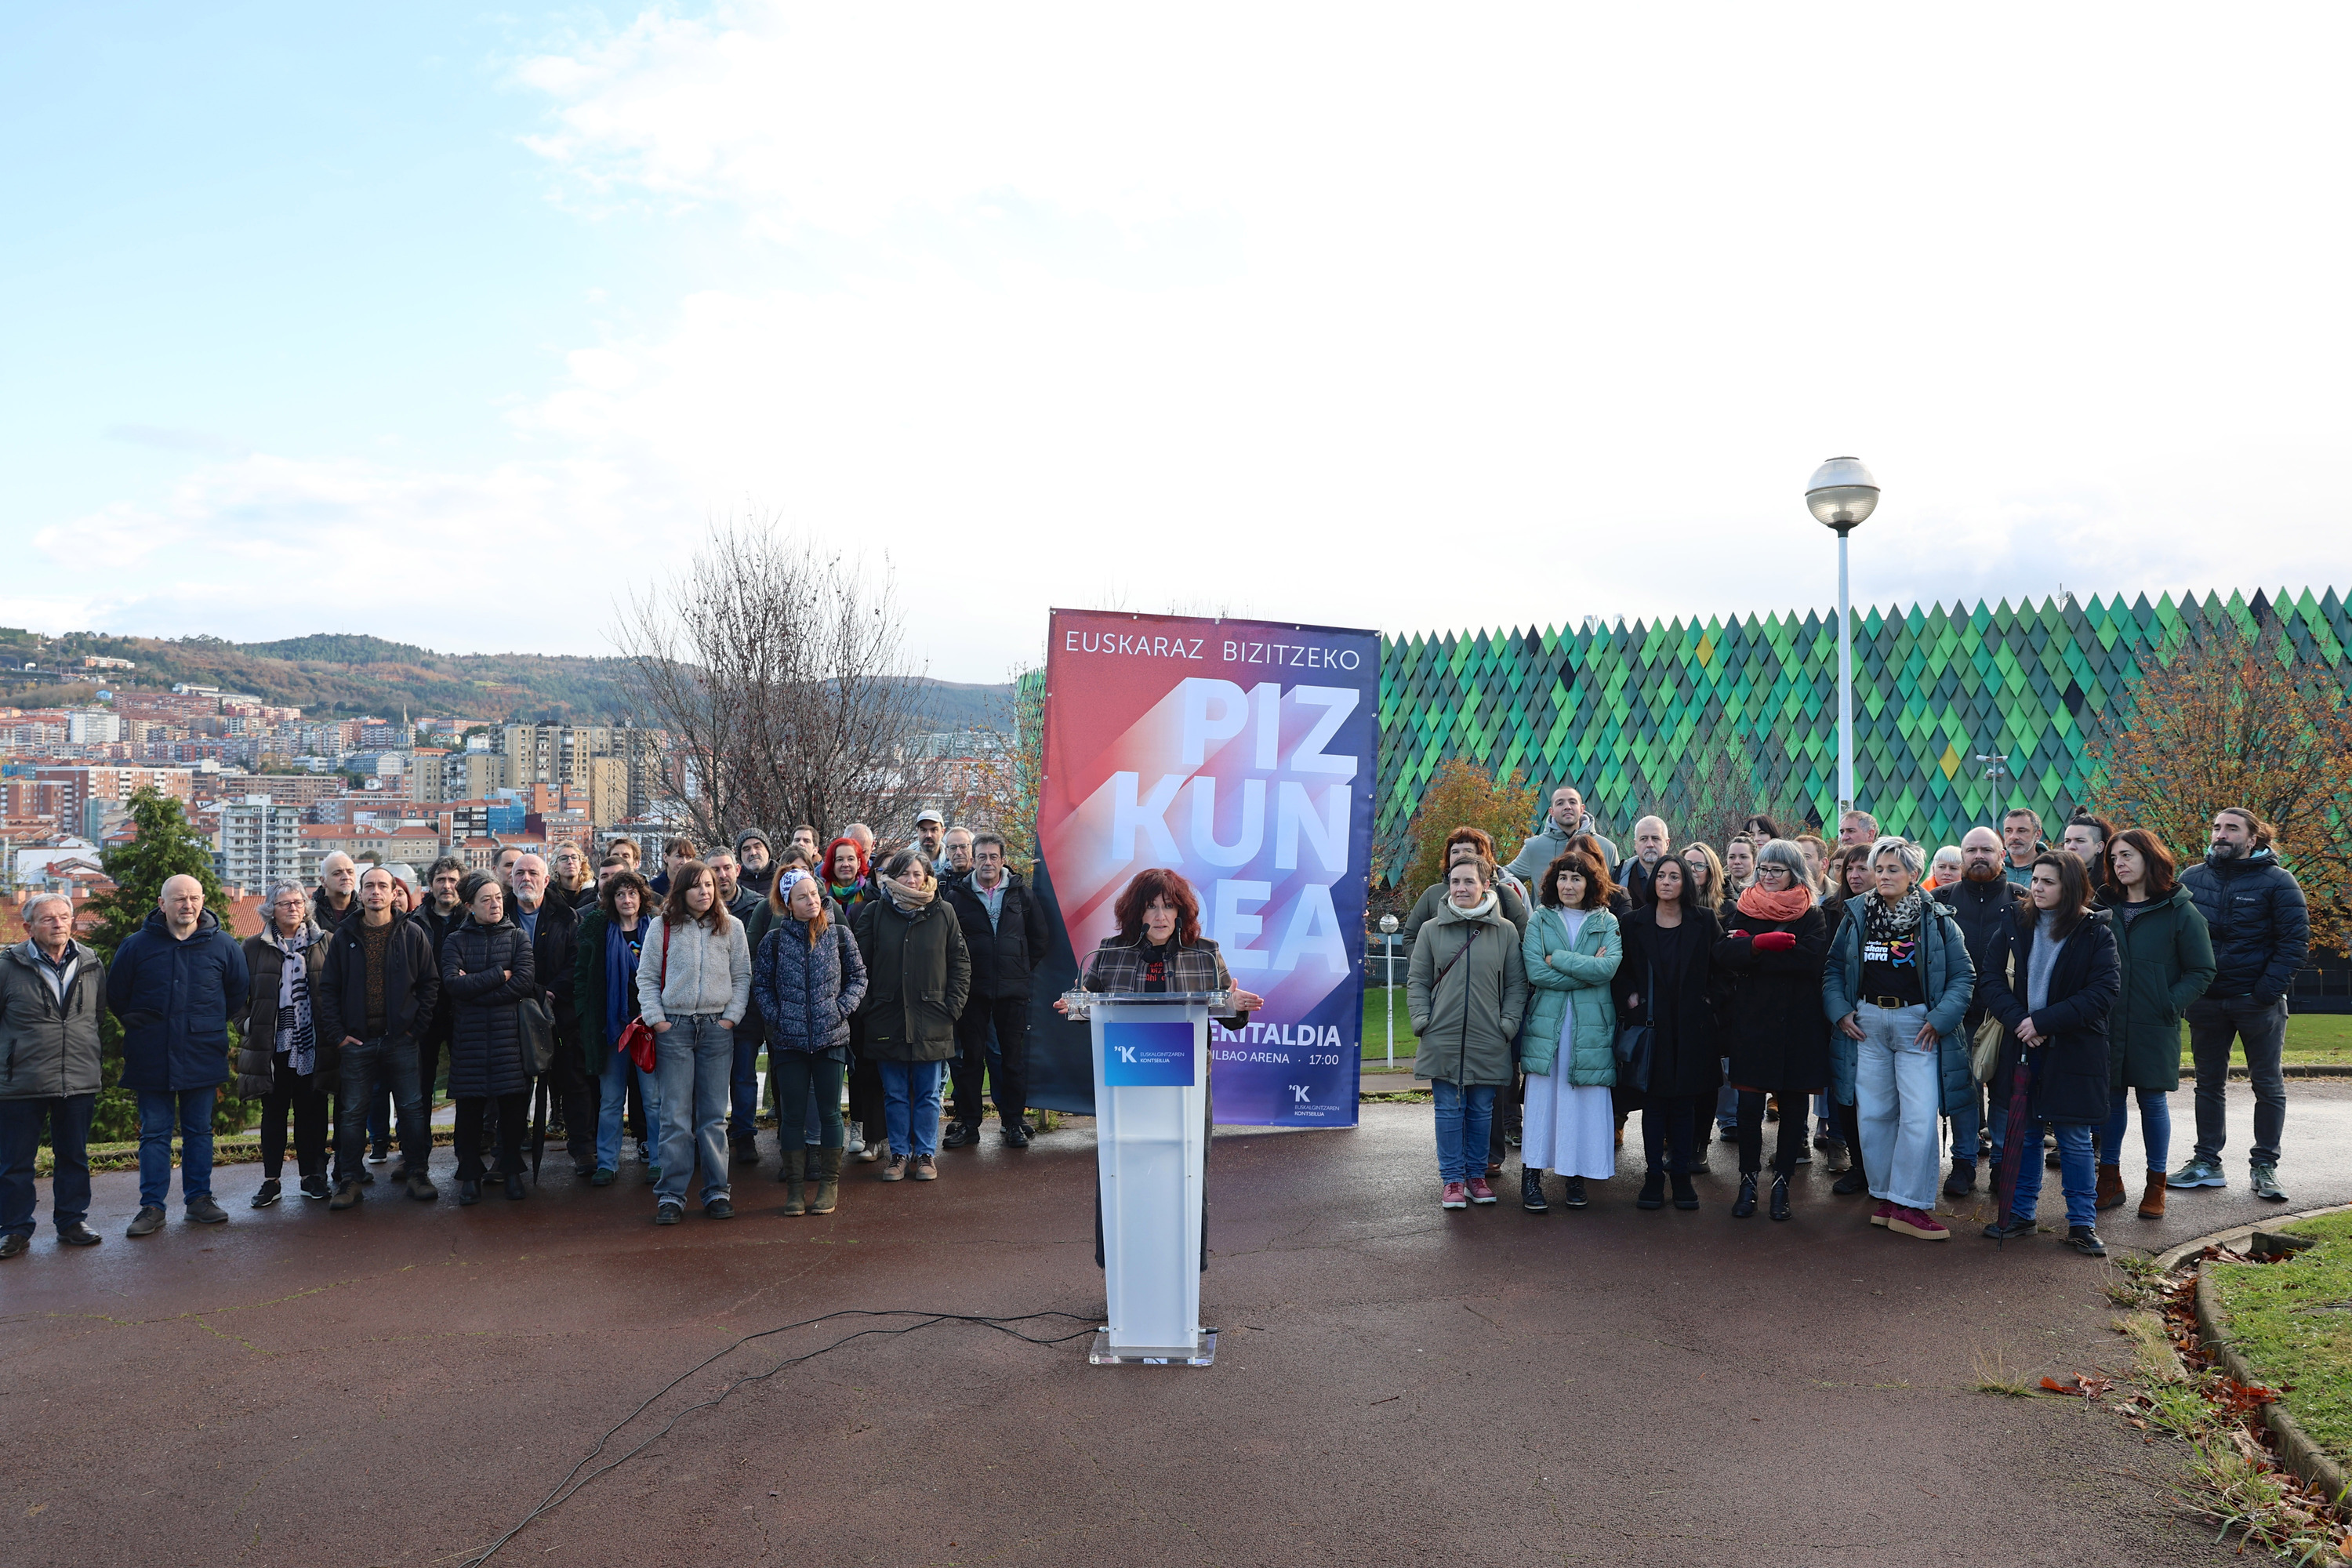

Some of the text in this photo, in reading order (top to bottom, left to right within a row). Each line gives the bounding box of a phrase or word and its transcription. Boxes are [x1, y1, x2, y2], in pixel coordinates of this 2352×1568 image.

[1066, 630, 1360, 670] EUSKARAZ BIZITZEKO
[1181, 677, 1360, 775] PIZ
[1112, 770, 1352, 873] KUN
[1189, 878, 1351, 974] EA
[1212, 1049, 1339, 1065] ILBAO ARENA 17:00
